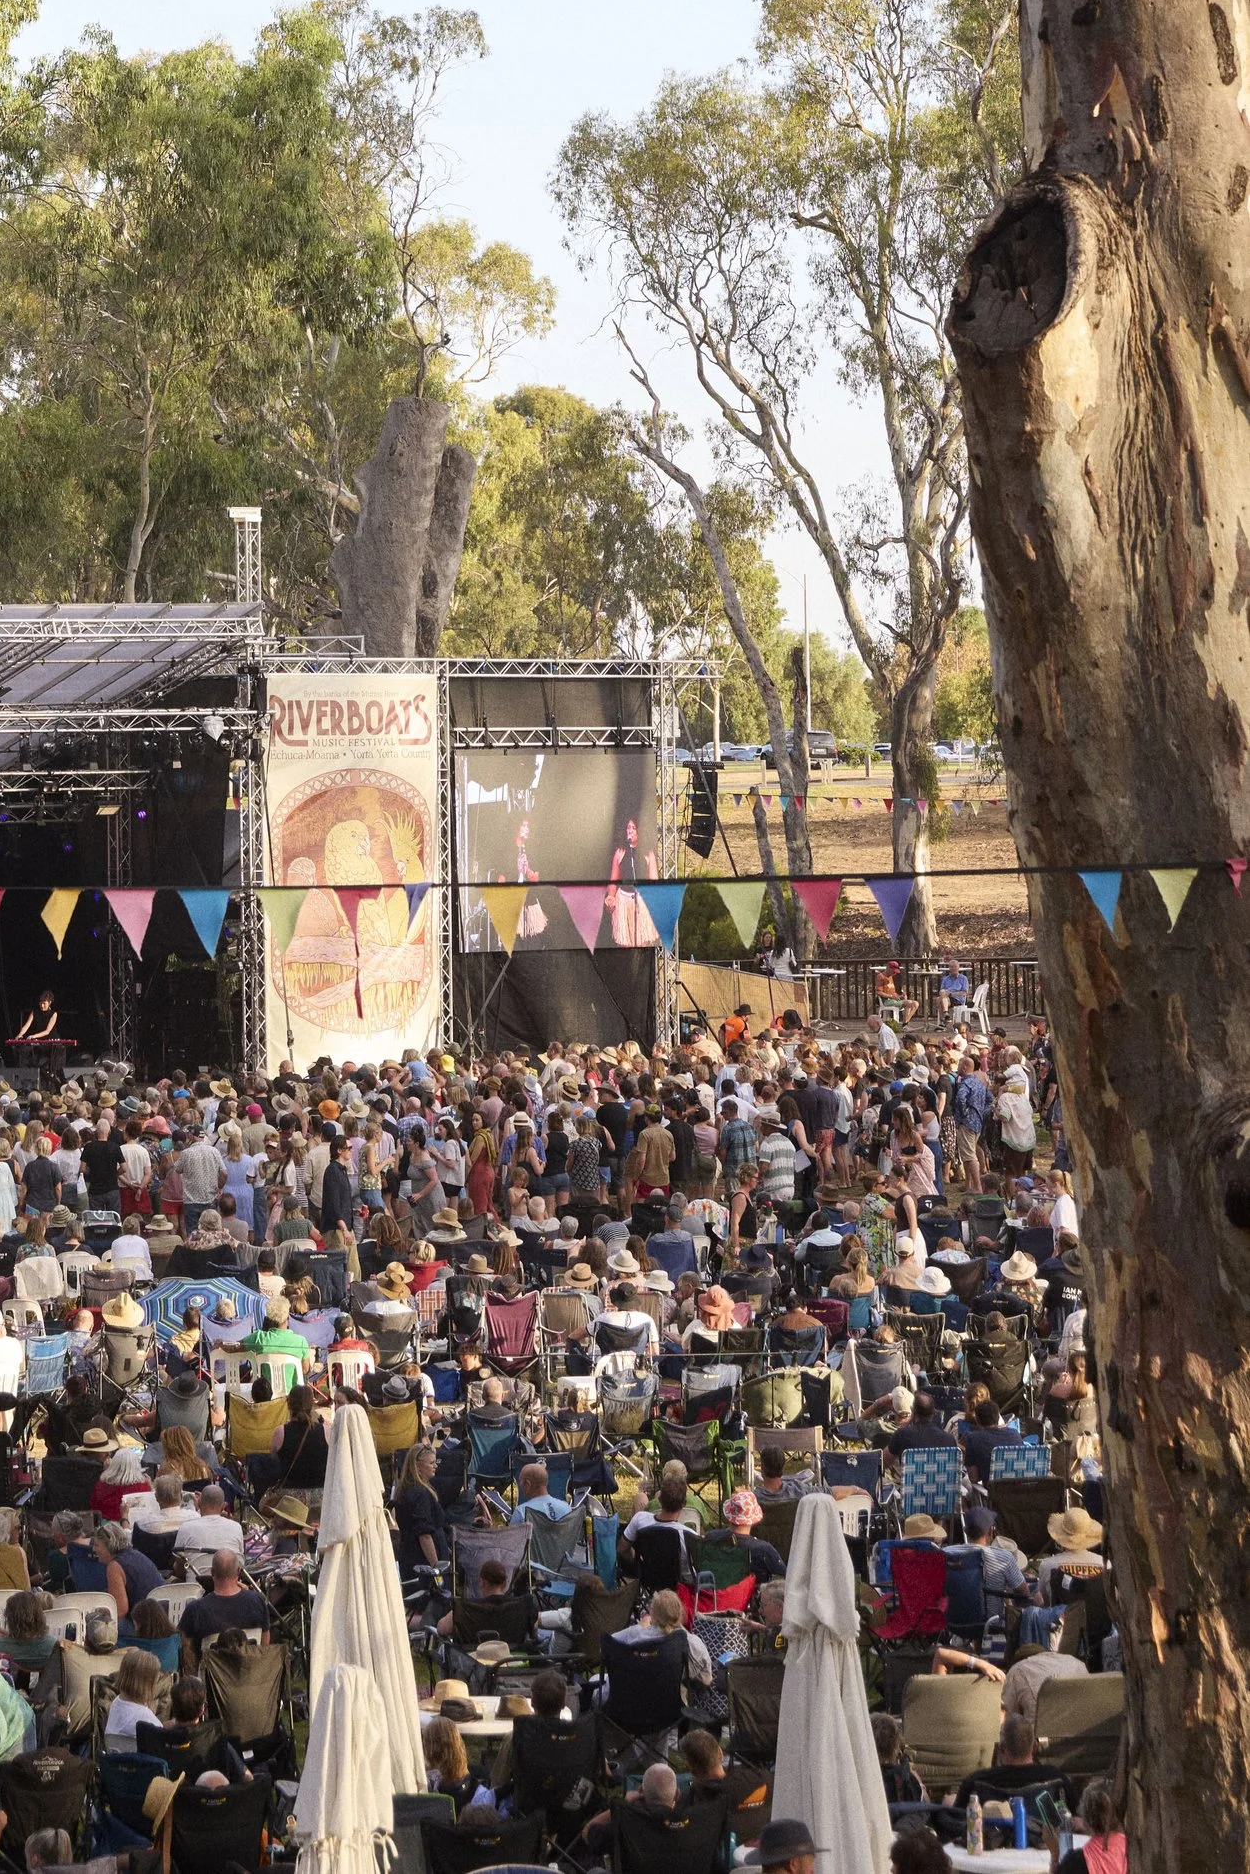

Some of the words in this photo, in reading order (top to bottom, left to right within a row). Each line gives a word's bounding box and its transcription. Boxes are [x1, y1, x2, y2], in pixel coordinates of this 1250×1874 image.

[269, 694, 432, 747] RIVERBOATS
[312, 739, 345, 747] MUSIC
[348, 738, 396, 746] FESTIVAL
[270, 750, 340, 760] Echuca-Moama
[350, 750, 374, 759] Yorta
[376, 750, 399, 759] Yorta
[401, 749, 432, 761] Country
[1062, 1286, 1076, 1295] IAN
